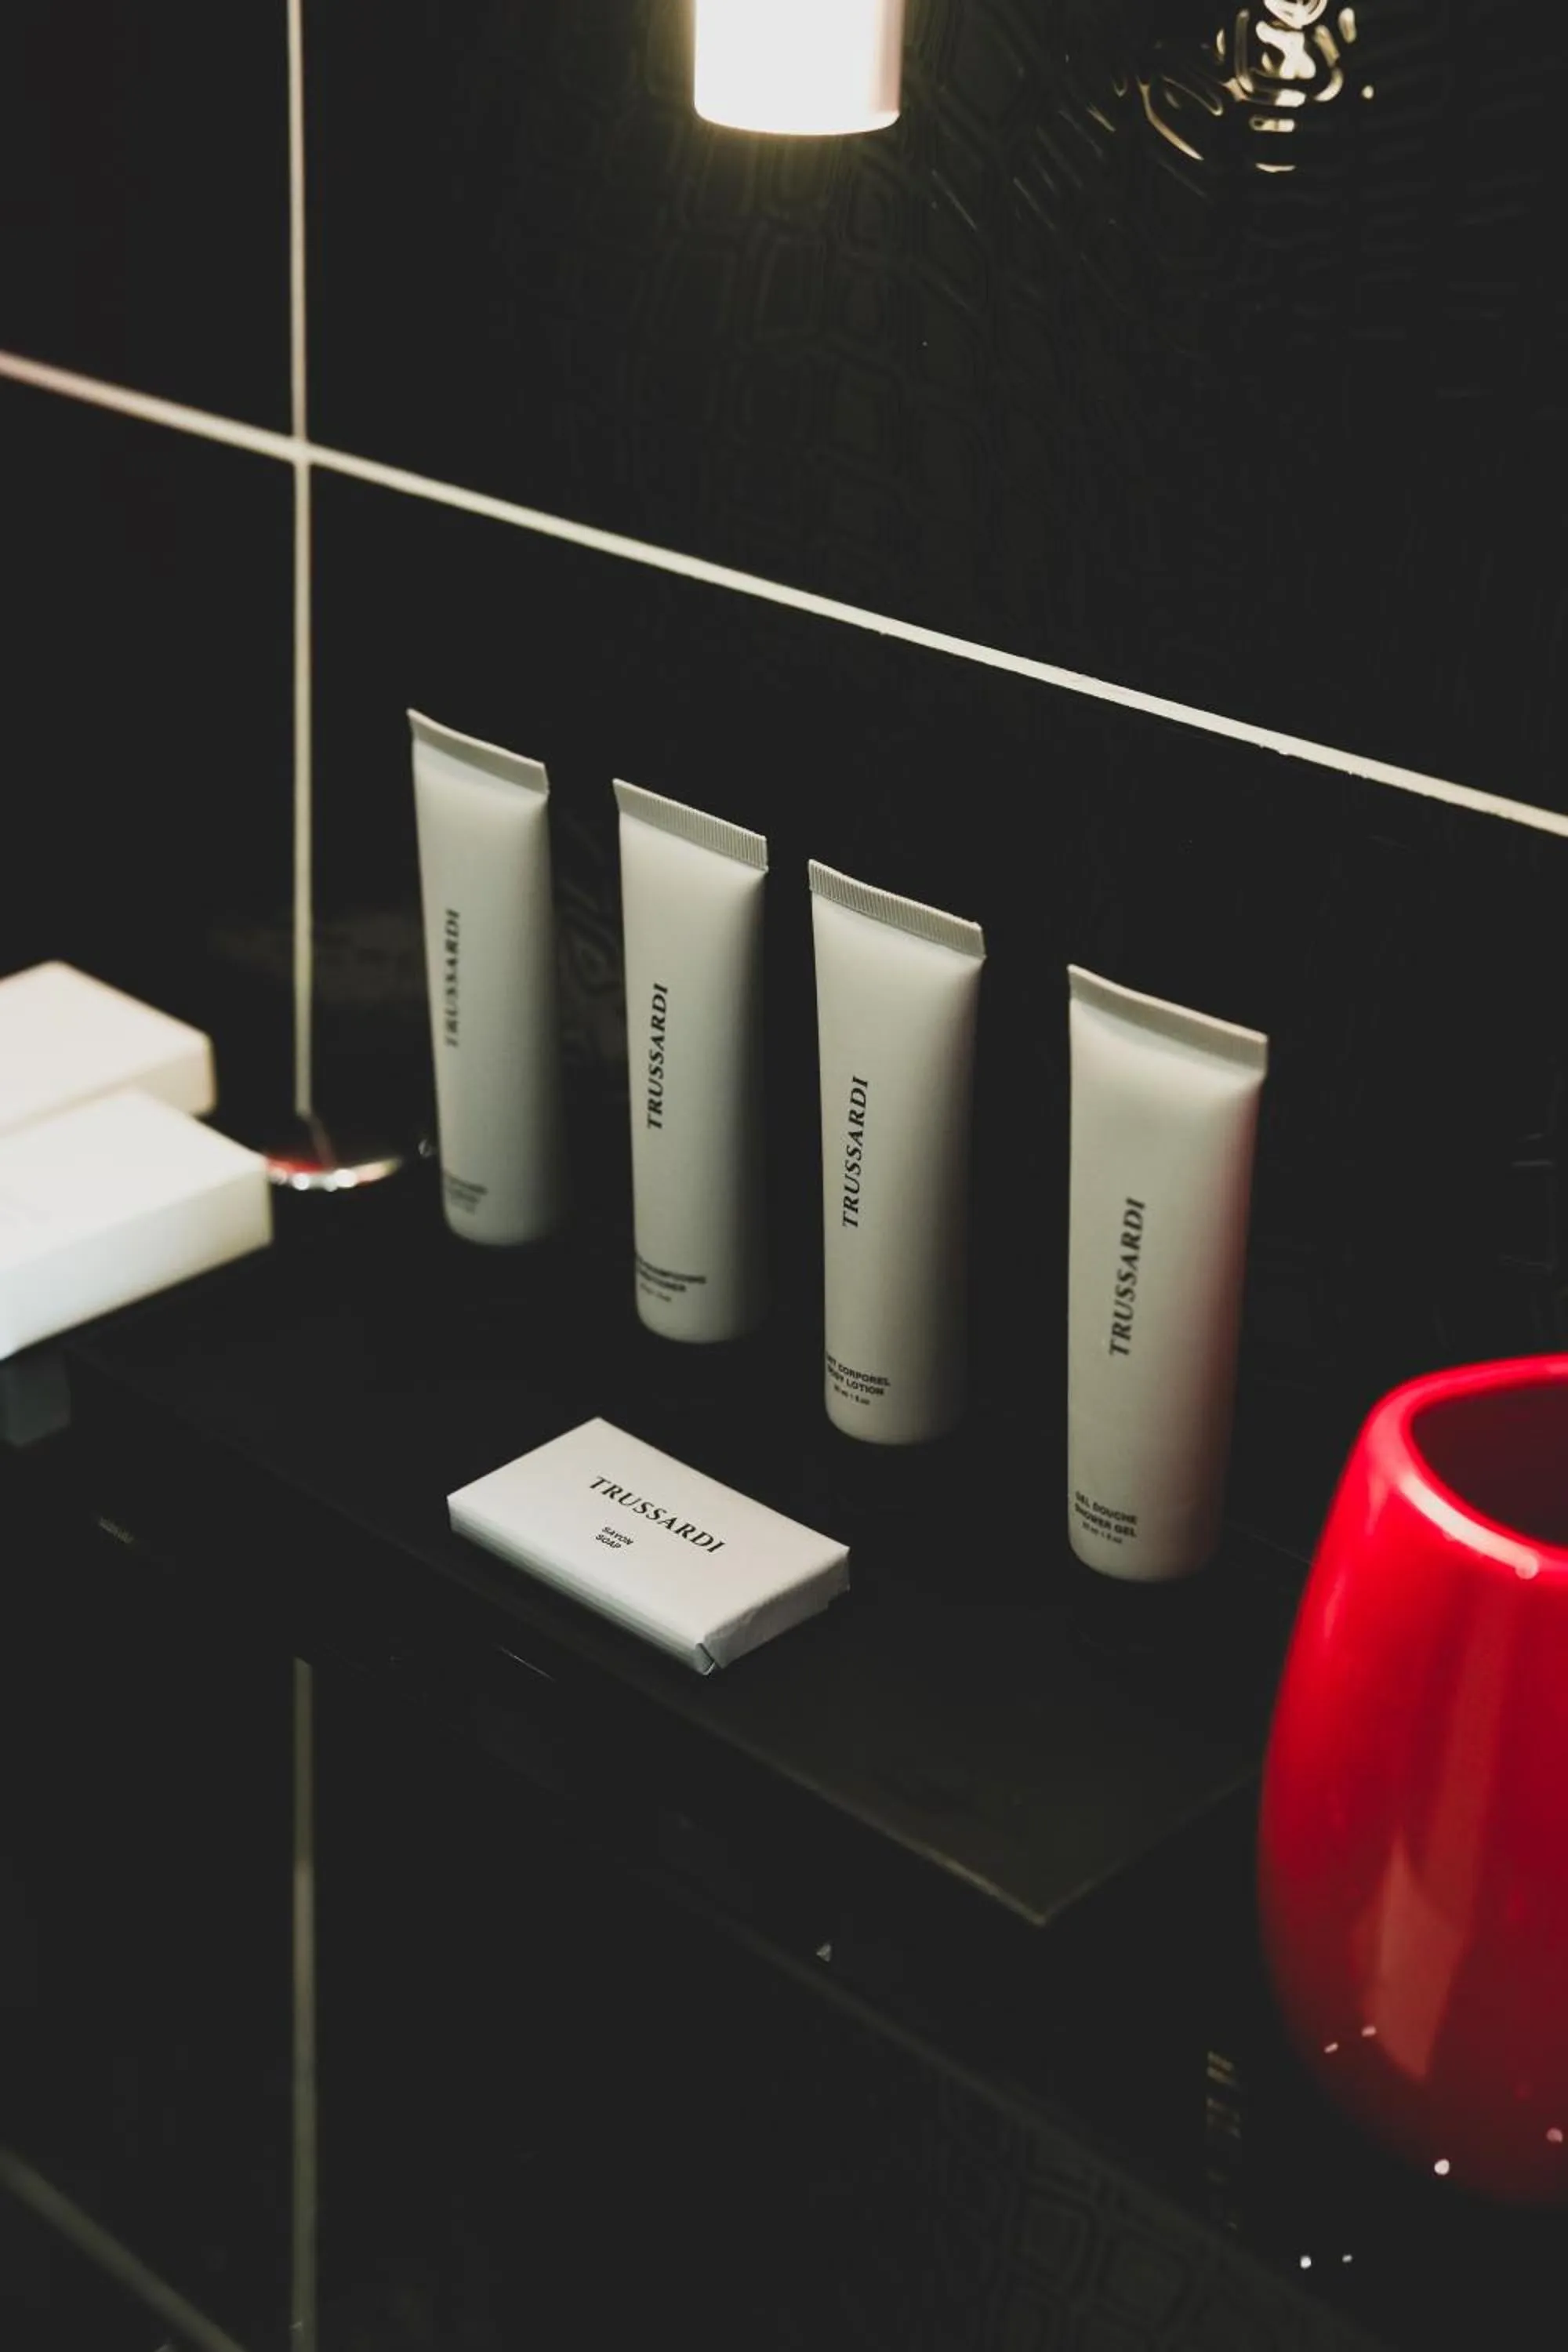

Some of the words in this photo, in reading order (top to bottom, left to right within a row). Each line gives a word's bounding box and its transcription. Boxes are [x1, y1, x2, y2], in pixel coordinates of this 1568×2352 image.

[445, 908, 461, 1049] TRUSSARDI
[646, 982, 669, 1130] TRUSSARDI
[842, 1076, 868, 1228] TRUSSARDI
[1109, 1196, 1146, 1356] TRUSSARDI
[847, 1378, 884, 1396] LOTION
[590, 1475, 726, 1553] TRUSSARDI
[1093, 1501, 1138, 1526] DOUCHE
[1114, 1524, 1138, 1537] GEL
